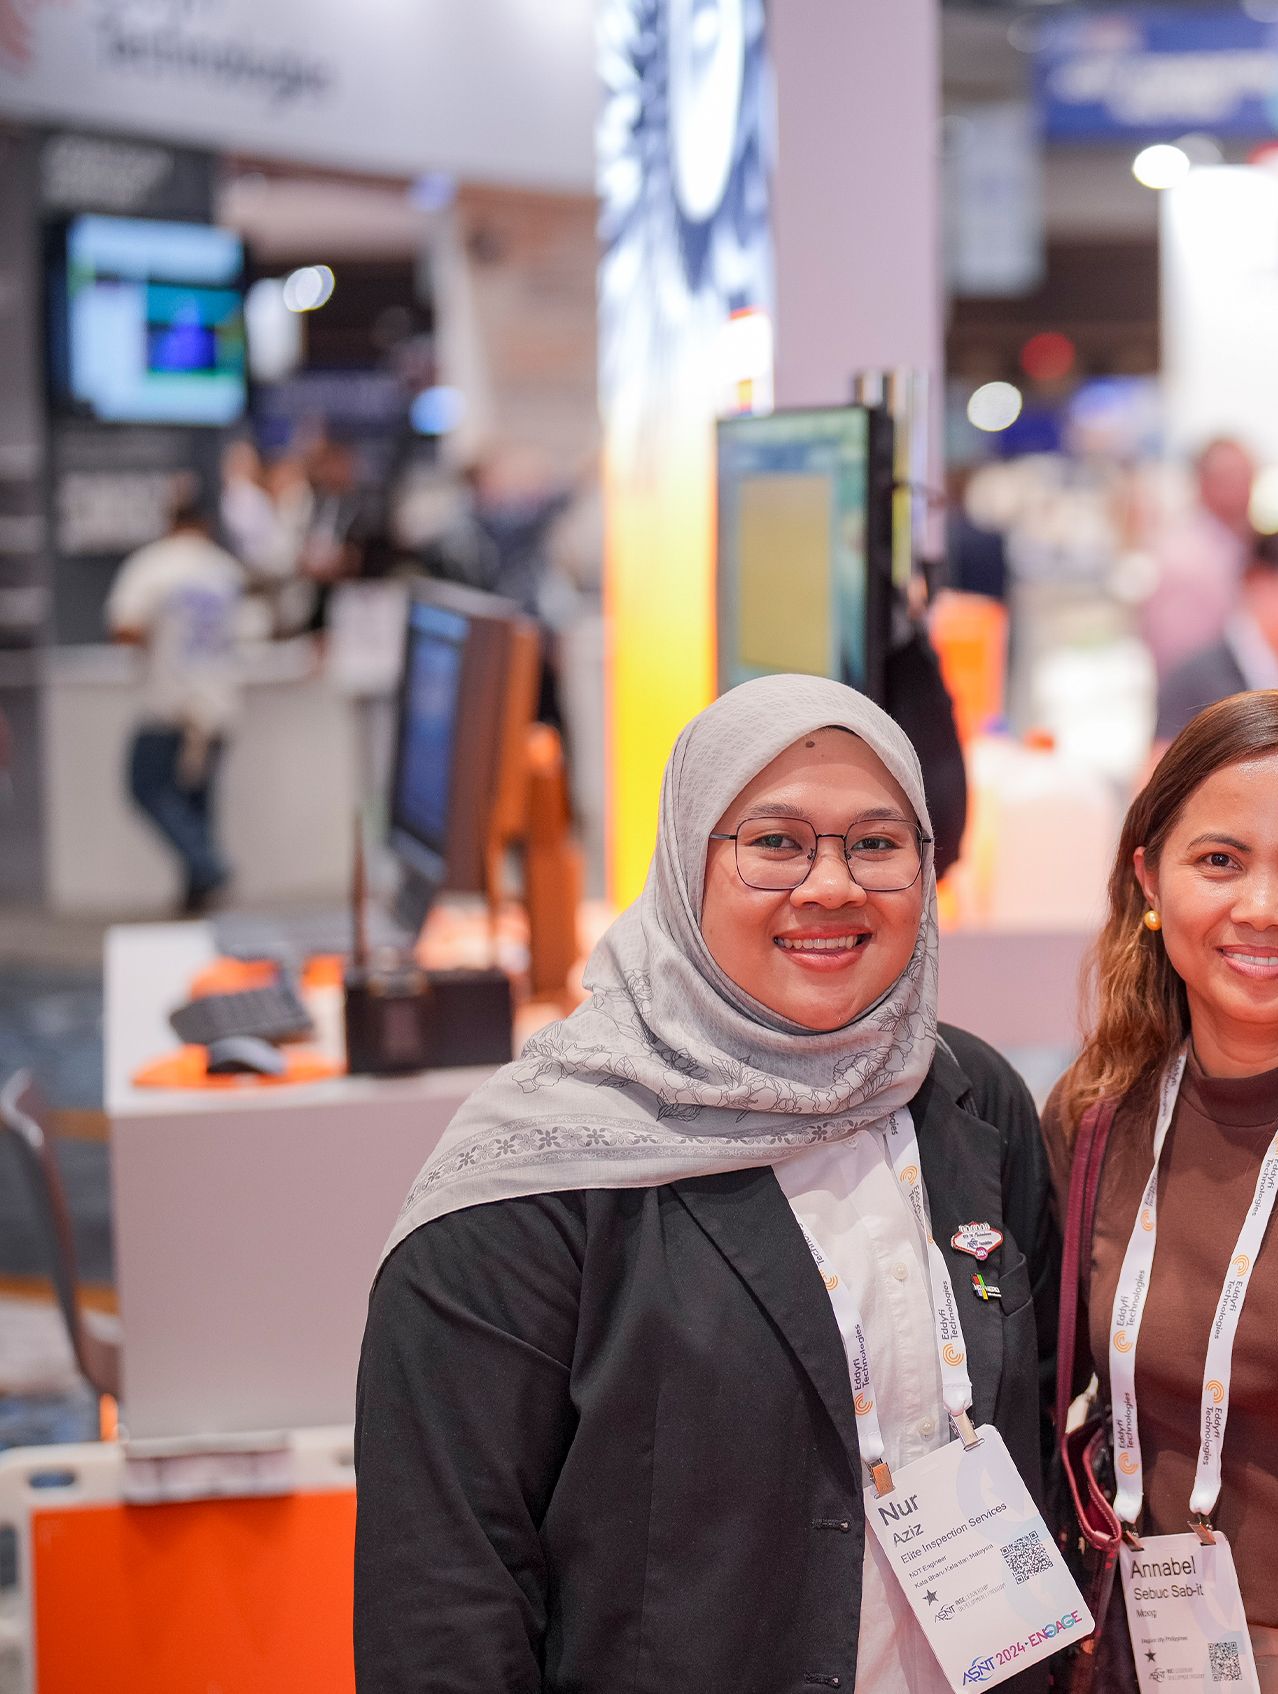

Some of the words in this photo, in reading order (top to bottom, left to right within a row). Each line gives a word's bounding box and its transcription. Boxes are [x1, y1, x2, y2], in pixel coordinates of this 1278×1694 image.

[1251, 1158, 1274, 1217] Technologies
[944, 1280, 959, 1340] Technologies
[1116, 1296, 1129, 1327] Eddyfi
[1126, 1269, 1146, 1327] Technologies
[1214, 1280, 1236, 1340] Technologies
[1230, 1280, 1244, 1312] Eddyfi
[939, 1309, 949, 1340] Eddyfi
[856, 1323, 870, 1389] Technologies
[854, 1358, 862, 1391] Eddyfi
[1118, 1419, 1127, 1449] Eddyfi
[1126, 1392, 1135, 1449] Technologies
[1202, 1406, 1214, 1466] Technologies
[1213, 1407, 1223, 1439] Eddyfi
[878, 1494, 920, 1527] Nur
[892, 1522, 925, 1548] Aziz
[900, 1547, 922, 1564] Elite
[922, 1524, 968, 1552] Inspection
[969, 1502, 1007, 1528] Services
[922, 1554, 948, 1571] Engineer
[969, 1543, 993, 1559] Malaysia
[1130, 1555, 1197, 1580] Annabel
[1134, 1586, 1170, 1601] Sebuc
[1171, 1583, 1205, 1599] Sab-it
[962, 1656, 995, 1686] ASNT
